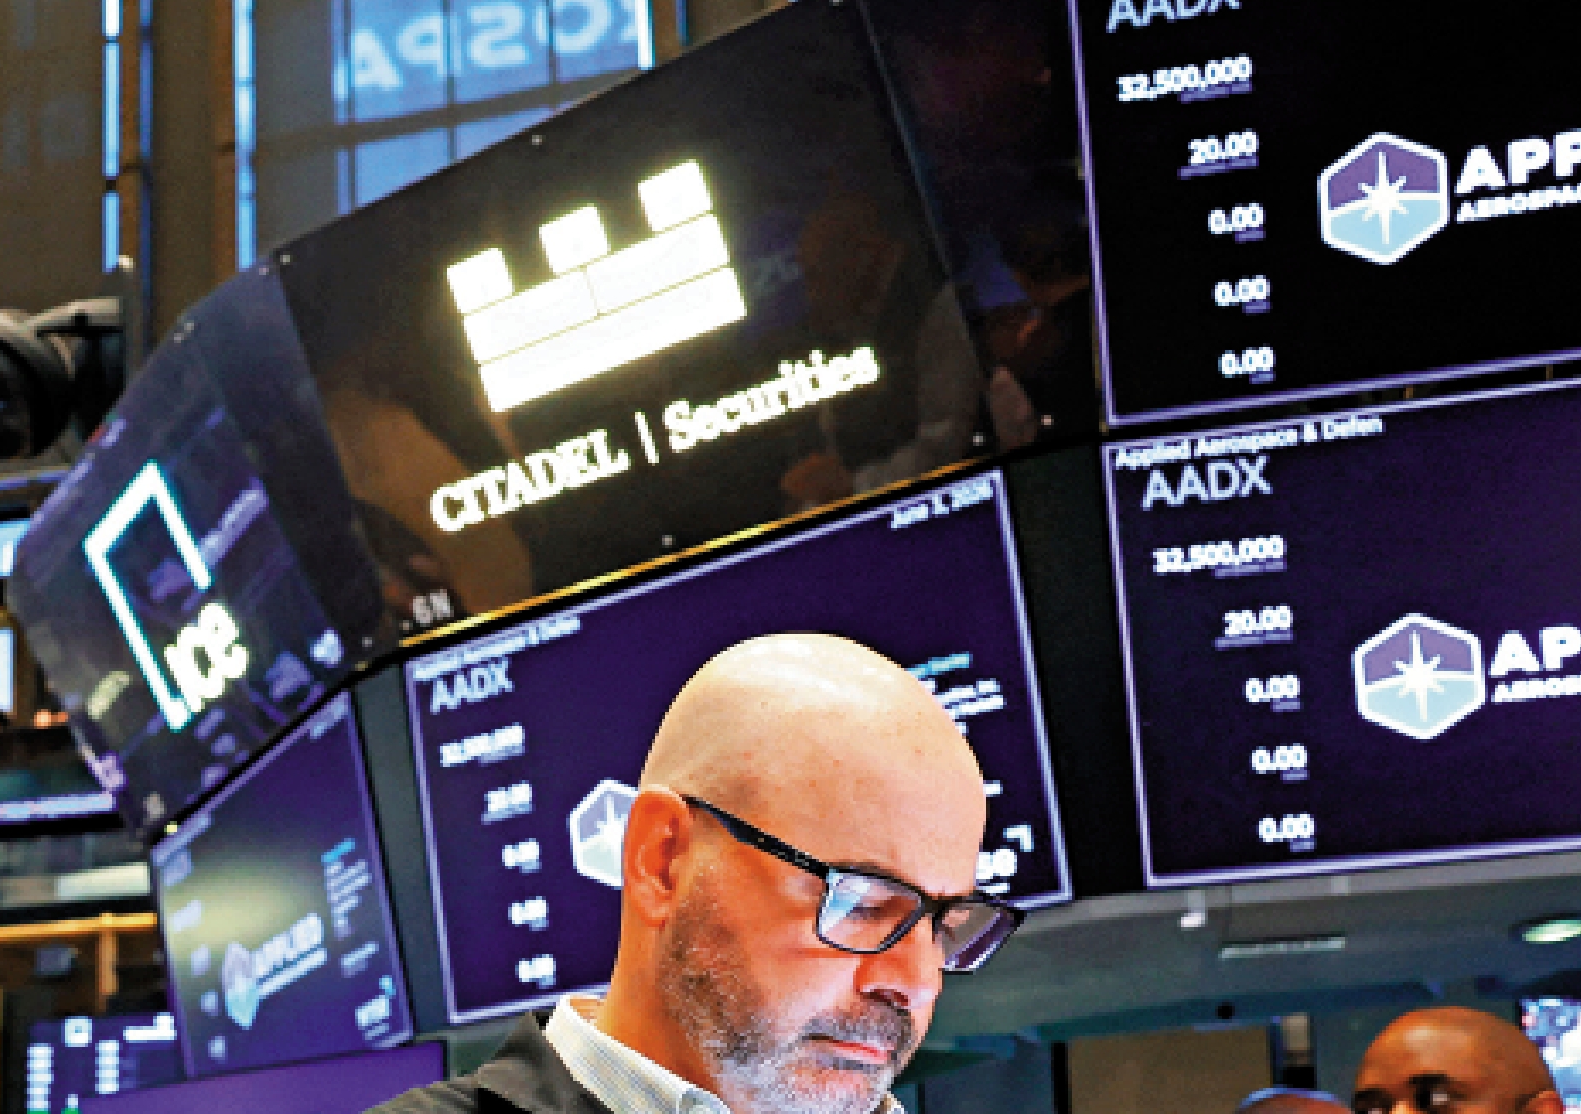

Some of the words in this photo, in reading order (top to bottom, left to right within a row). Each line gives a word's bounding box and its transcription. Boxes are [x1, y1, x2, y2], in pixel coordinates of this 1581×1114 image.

[1106, 0, 1243, 34] AA
[1116, 53, 1253, 102] 32,500,000
[1188, 129, 1259, 165] 20.00
[1208, 203, 1264, 235] 0.00
[1214, 275, 1270, 306] 0.00
[1219, 344, 1275, 378] 0.00
[430, 429, 629, 533] CITADEL
[663, 346, 880, 451] Securities
[1115, 440, 1190, 470] Applied
[1142, 455, 1273, 510] AADX
[1152, 534, 1287, 576] 32,500,000
[1223, 604, 1294, 638] 20.00
[430, 656, 514, 715] AADX
[1245, 674, 1300, 704] 0.00
[1252, 743, 1308, 774] 0.00
[1258, 812, 1315, 843] 0.00
